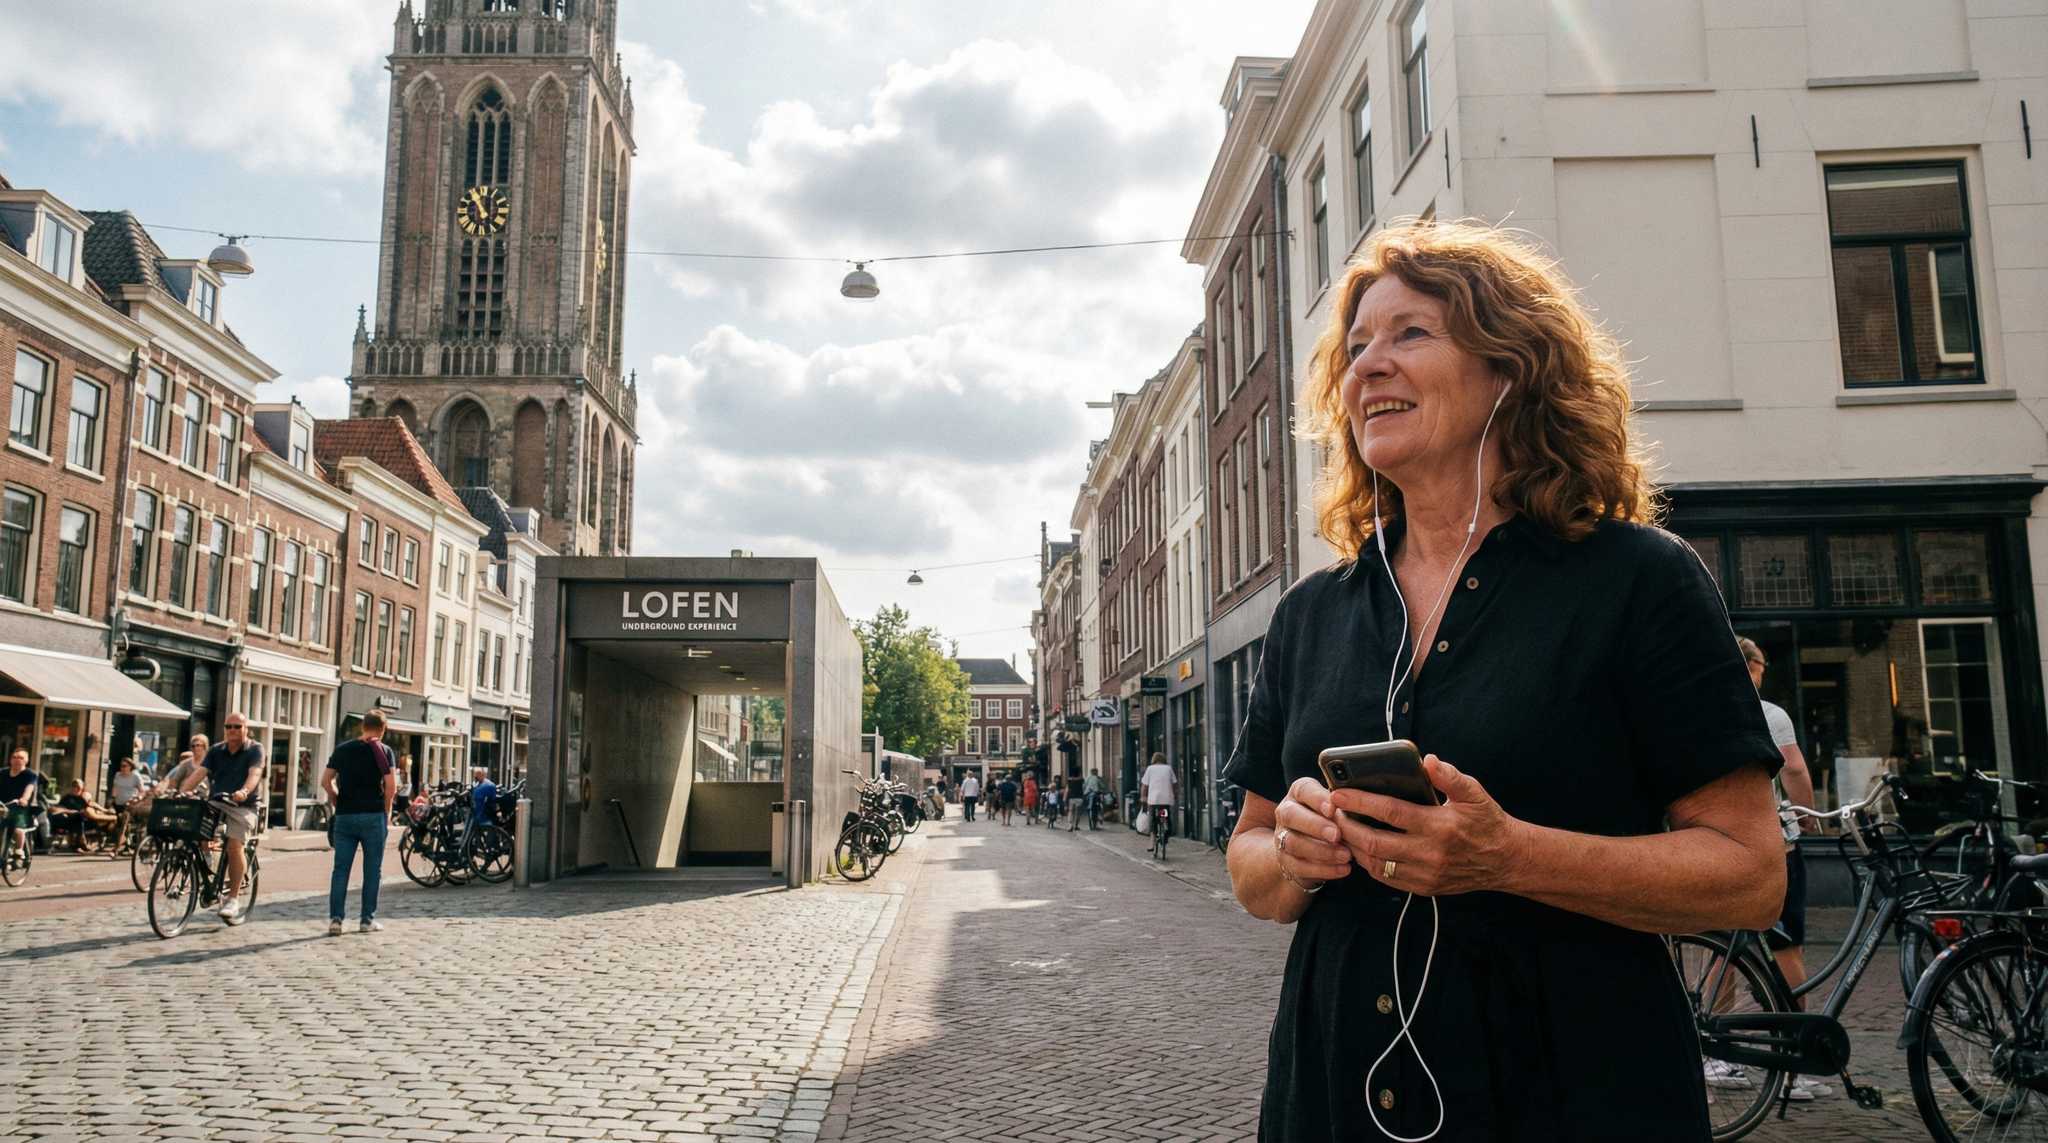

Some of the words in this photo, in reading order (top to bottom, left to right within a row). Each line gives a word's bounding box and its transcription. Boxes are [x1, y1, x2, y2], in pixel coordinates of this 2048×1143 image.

[622, 591, 739, 618] LOFEN
[622, 622, 686, 631] UNDERGROUND
[687, 622, 737, 631] EXPERIENCE
